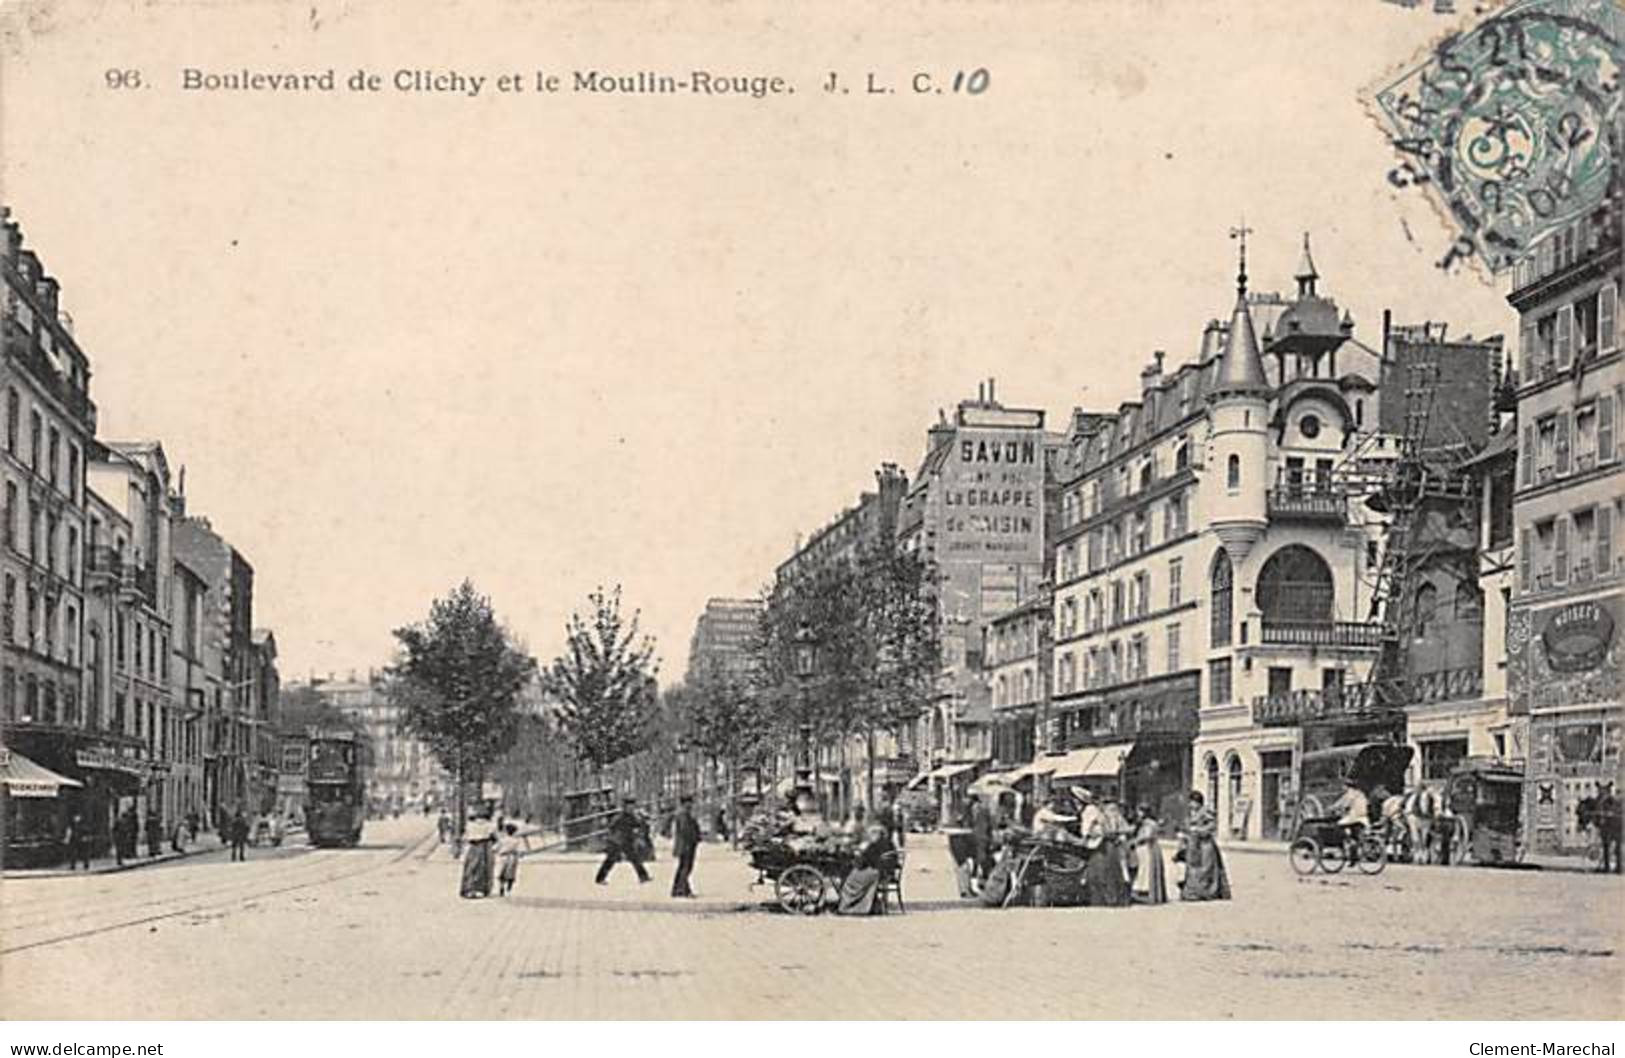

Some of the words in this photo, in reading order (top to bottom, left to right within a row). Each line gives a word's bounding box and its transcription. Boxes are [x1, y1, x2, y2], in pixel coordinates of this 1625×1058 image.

[953, 68, 991, 95] 10
[961, 440, 1035, 465] SAVON
[945, 490, 963, 506] La
[968, 489, 1034, 508] GRAPPE
